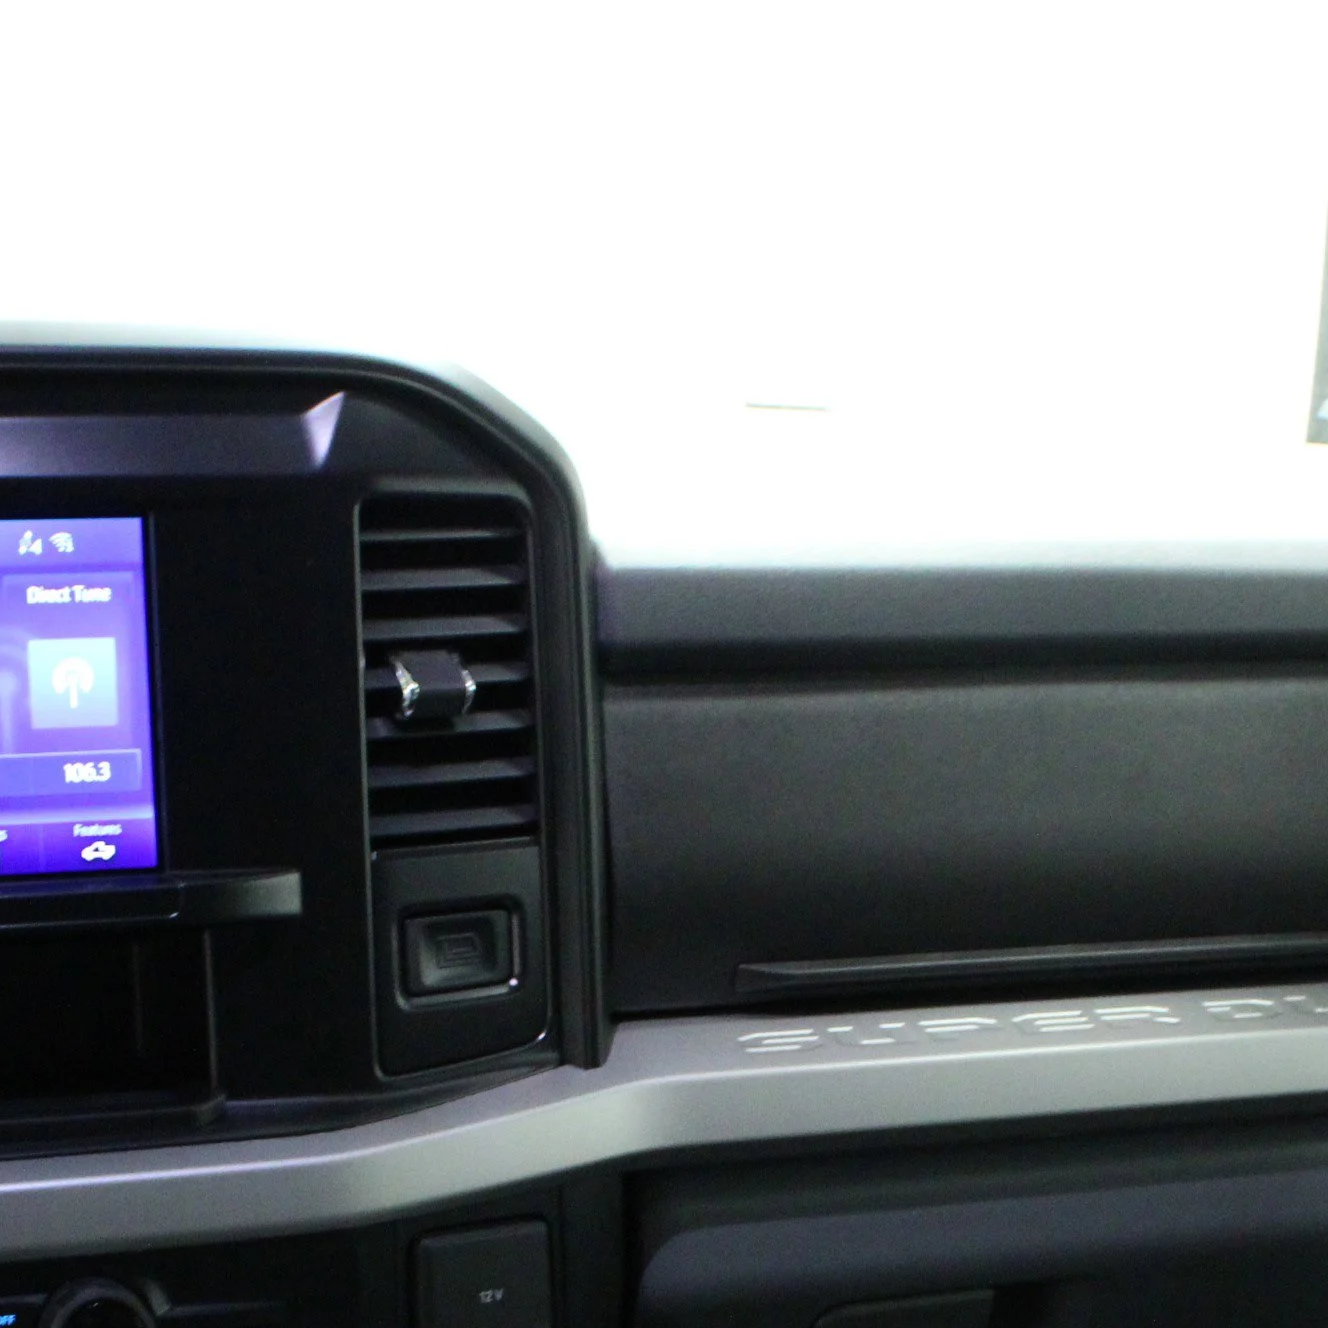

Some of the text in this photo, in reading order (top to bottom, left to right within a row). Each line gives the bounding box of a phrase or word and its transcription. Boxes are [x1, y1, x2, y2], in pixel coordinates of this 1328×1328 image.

[26, 585, 112, 605] Direct Tune
[63, 761, 112, 783] 106.3
[72, 824, 122, 837] Features
[735, 1004, 1182, 1054] SUPER
[479, 1289, 504, 1304] 12V
